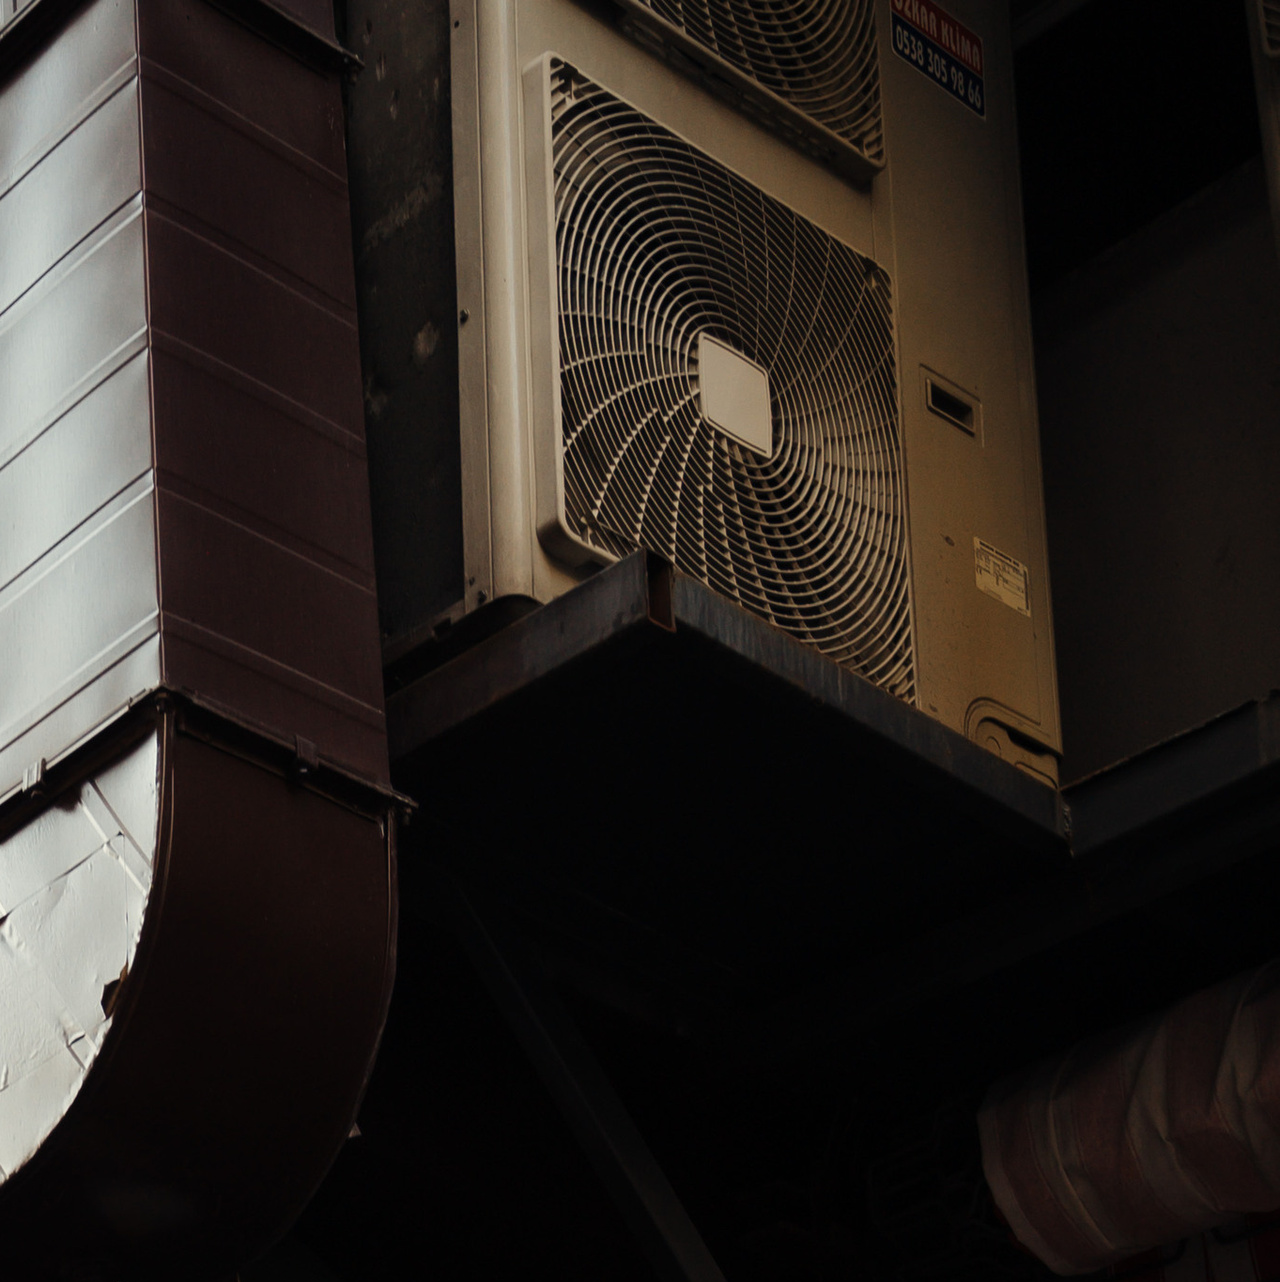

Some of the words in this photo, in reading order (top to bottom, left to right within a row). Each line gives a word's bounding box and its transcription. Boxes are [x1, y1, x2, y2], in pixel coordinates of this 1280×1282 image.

[896, 24, 924, 66] 0538
[926, 47, 947, 83] 305
[951, 66, 965, 97] 98
[968, 80, 982, 109] 66
